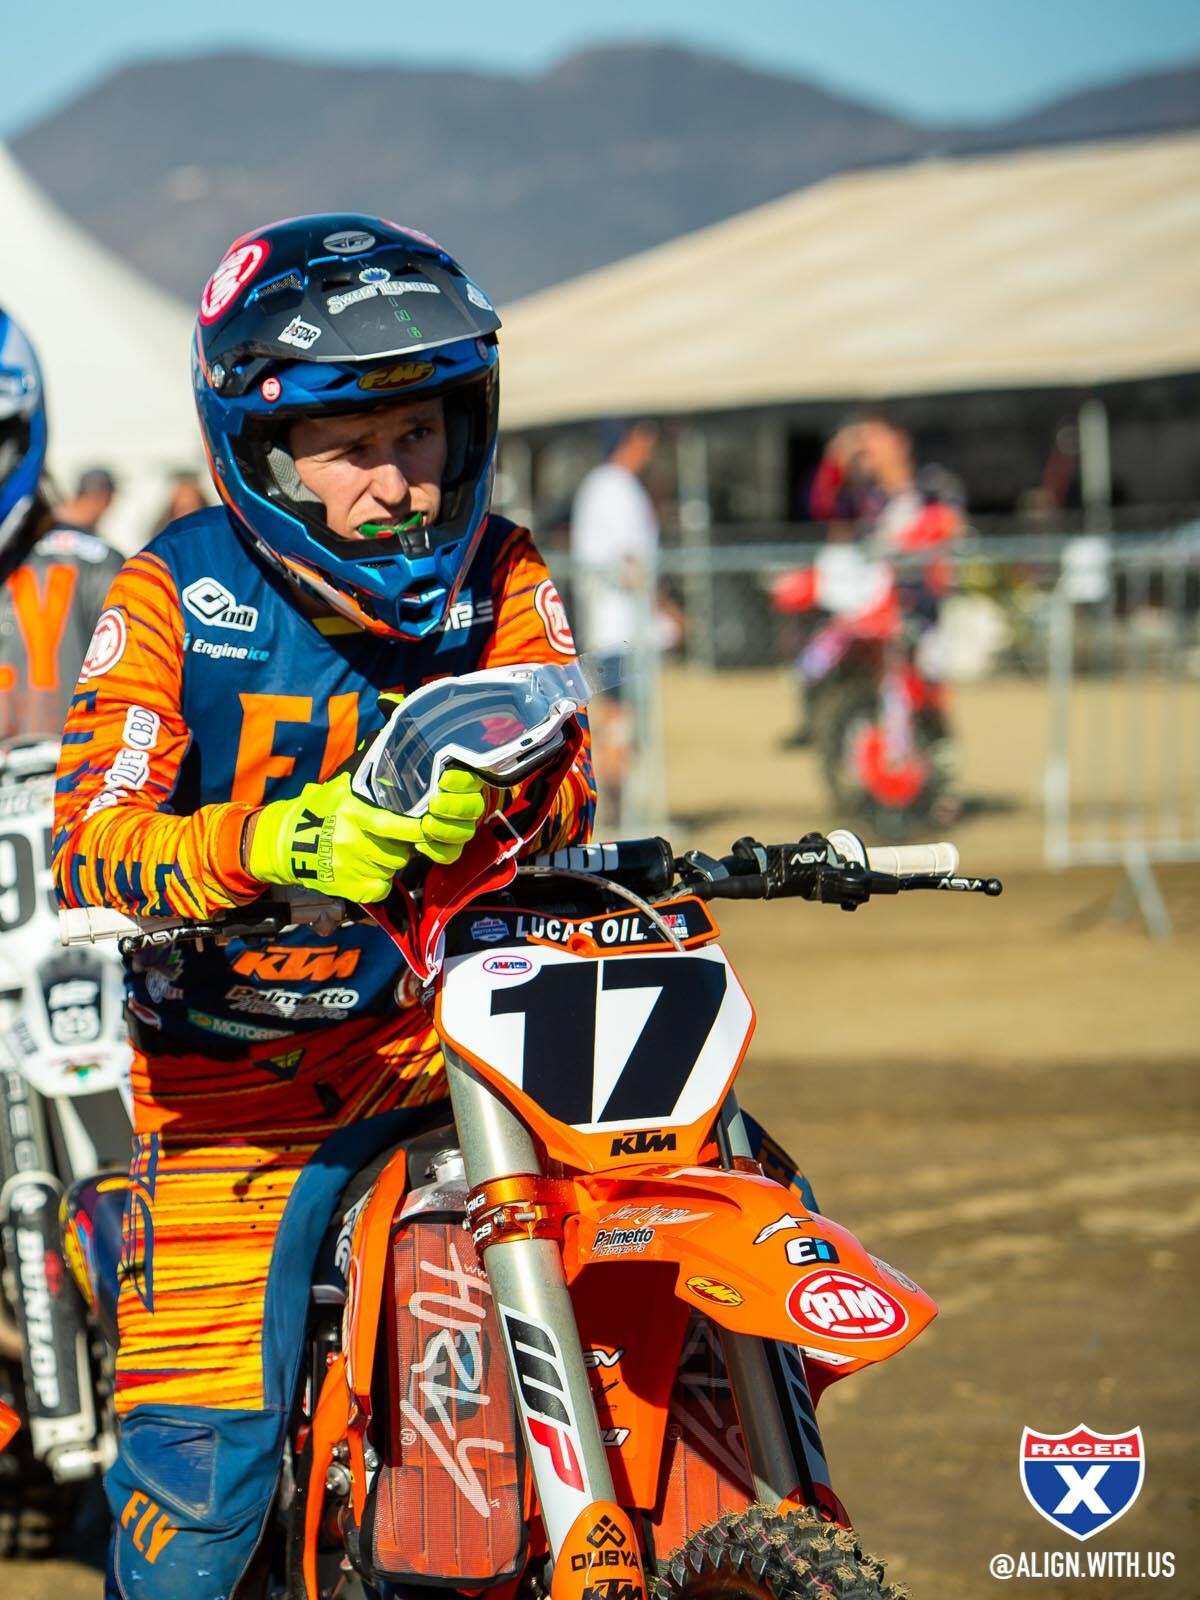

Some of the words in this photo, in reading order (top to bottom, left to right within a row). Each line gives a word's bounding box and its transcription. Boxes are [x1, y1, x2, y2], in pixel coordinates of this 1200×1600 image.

[292, 808, 326, 881] FLY
[790, 851, 826, 866] ASV
[141, 928, 179, 948] ASV
[233, 945, 362, 982] KTM
[490, 956, 728, 1126] 17
[610, 1129, 677, 1157] KTM
[593, 1228, 655, 1249] Palmetto
[686, 1276, 744, 1307] FMF
[120, 1488, 179, 1565] FLY
